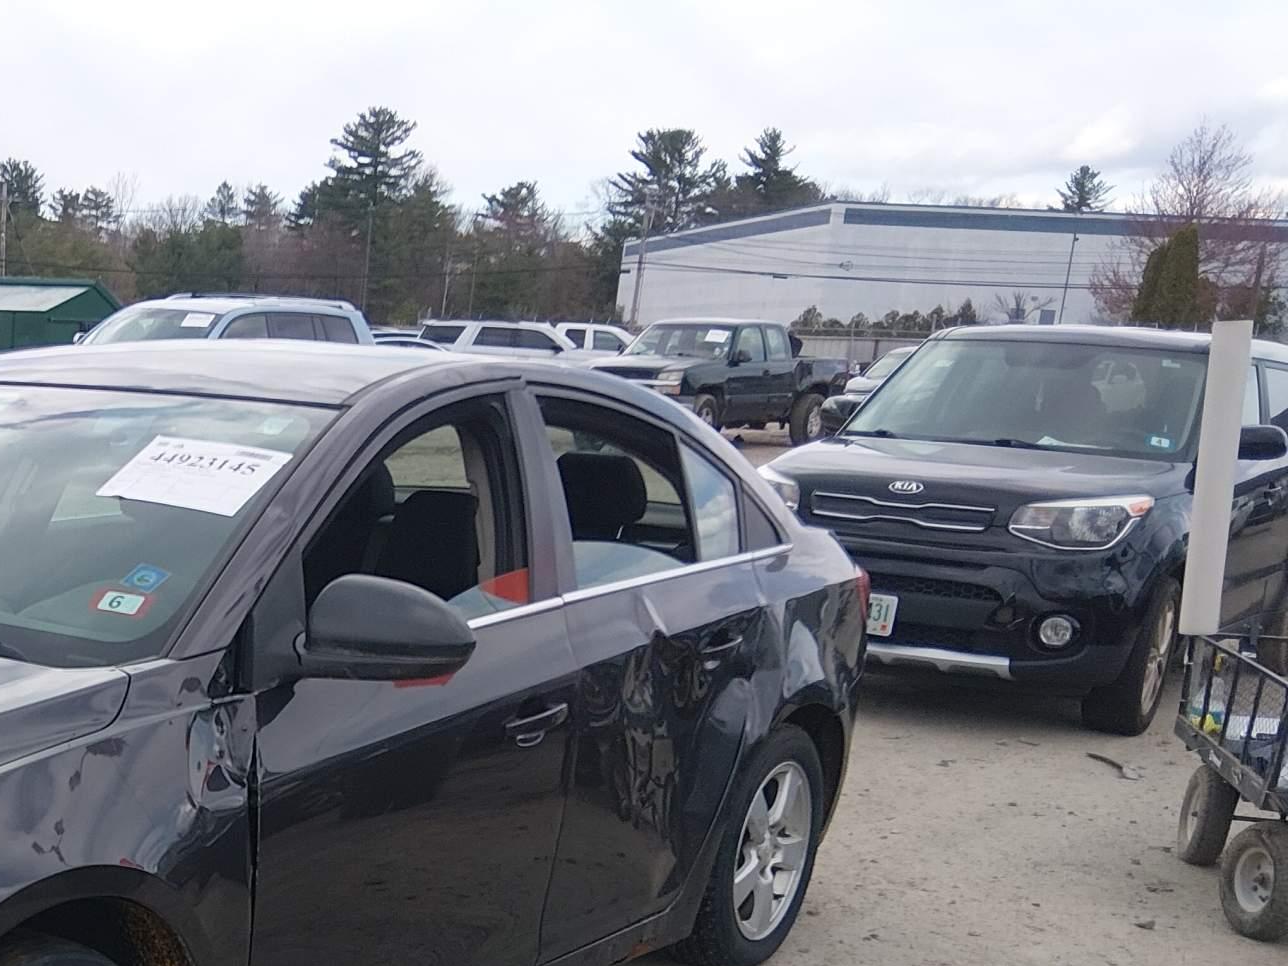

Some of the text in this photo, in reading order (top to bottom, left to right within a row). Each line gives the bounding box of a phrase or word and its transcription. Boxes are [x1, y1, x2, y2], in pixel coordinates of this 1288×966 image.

[150, 452, 261, 476] 44923145
[894, 479, 917, 491] KIA
[108, 595, 125, 609] 6
